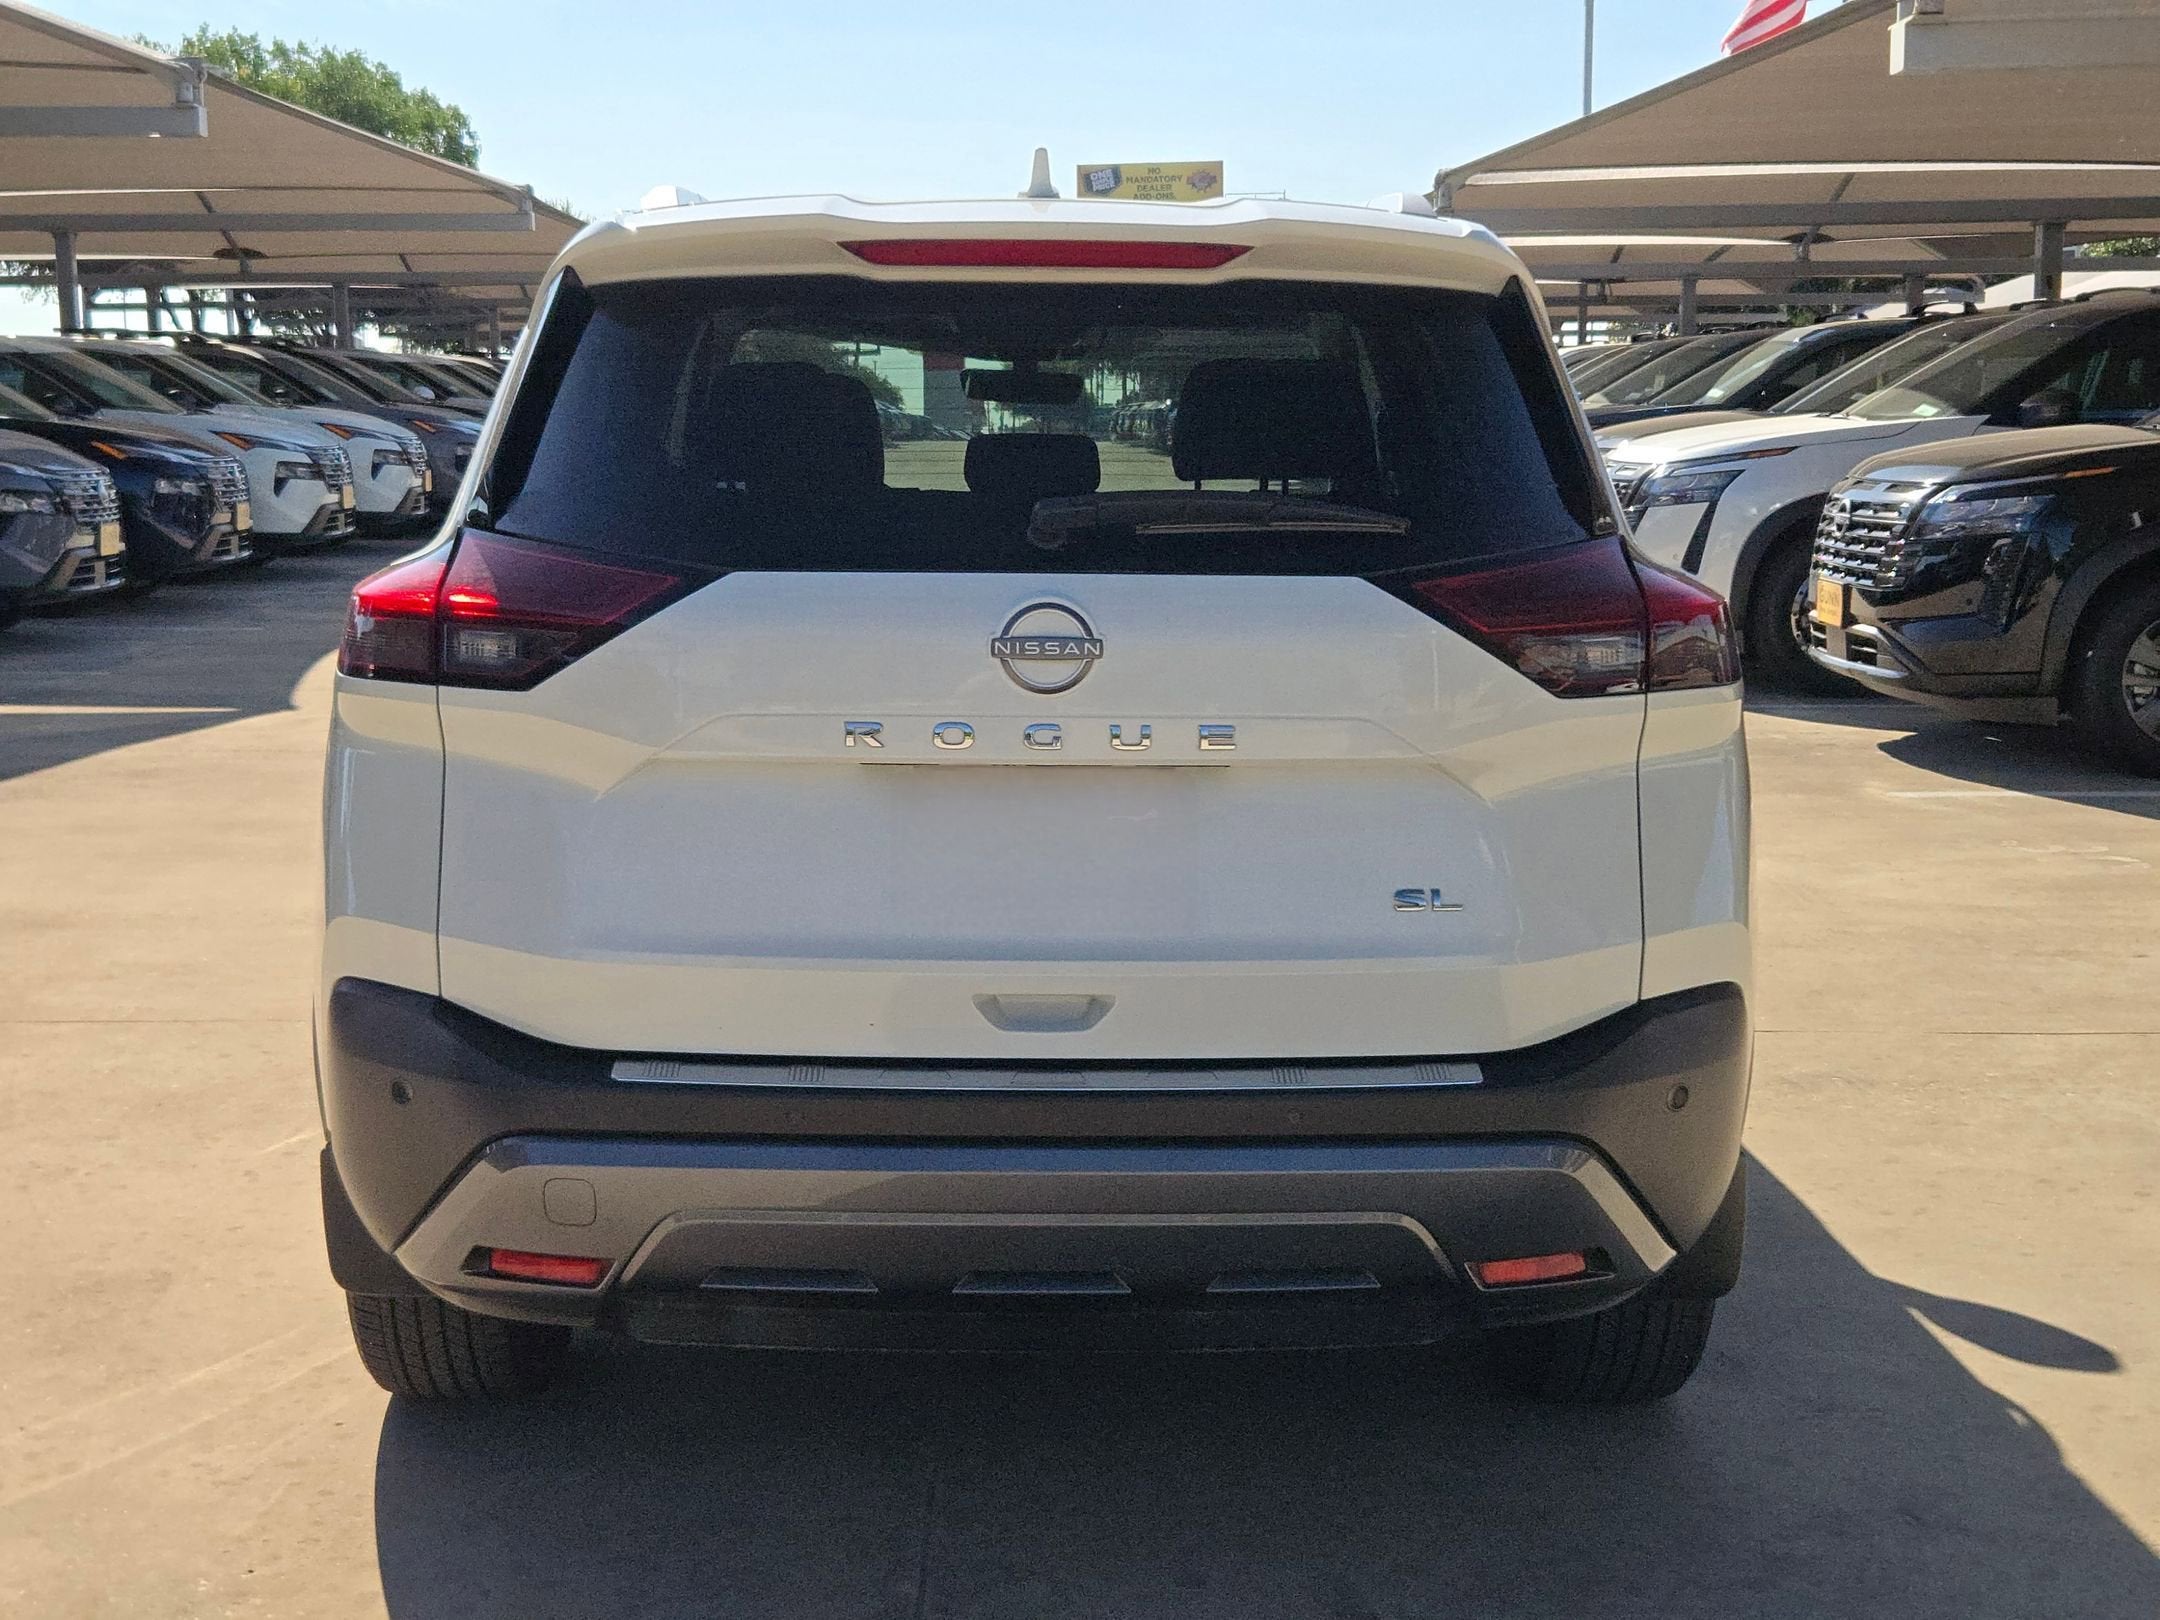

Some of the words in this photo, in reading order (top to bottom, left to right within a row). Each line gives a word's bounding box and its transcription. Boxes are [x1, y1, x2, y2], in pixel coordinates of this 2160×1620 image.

[1147, 167, 1161, 175] NO
[1126, 175, 1183, 184] MANDATORY
[1137, 184, 1172, 192] DEALER
[993, 640, 1101, 656] NISSAN
[843, 721, 1237, 751] ROGUE
[1393, 888, 1464, 911] SL
